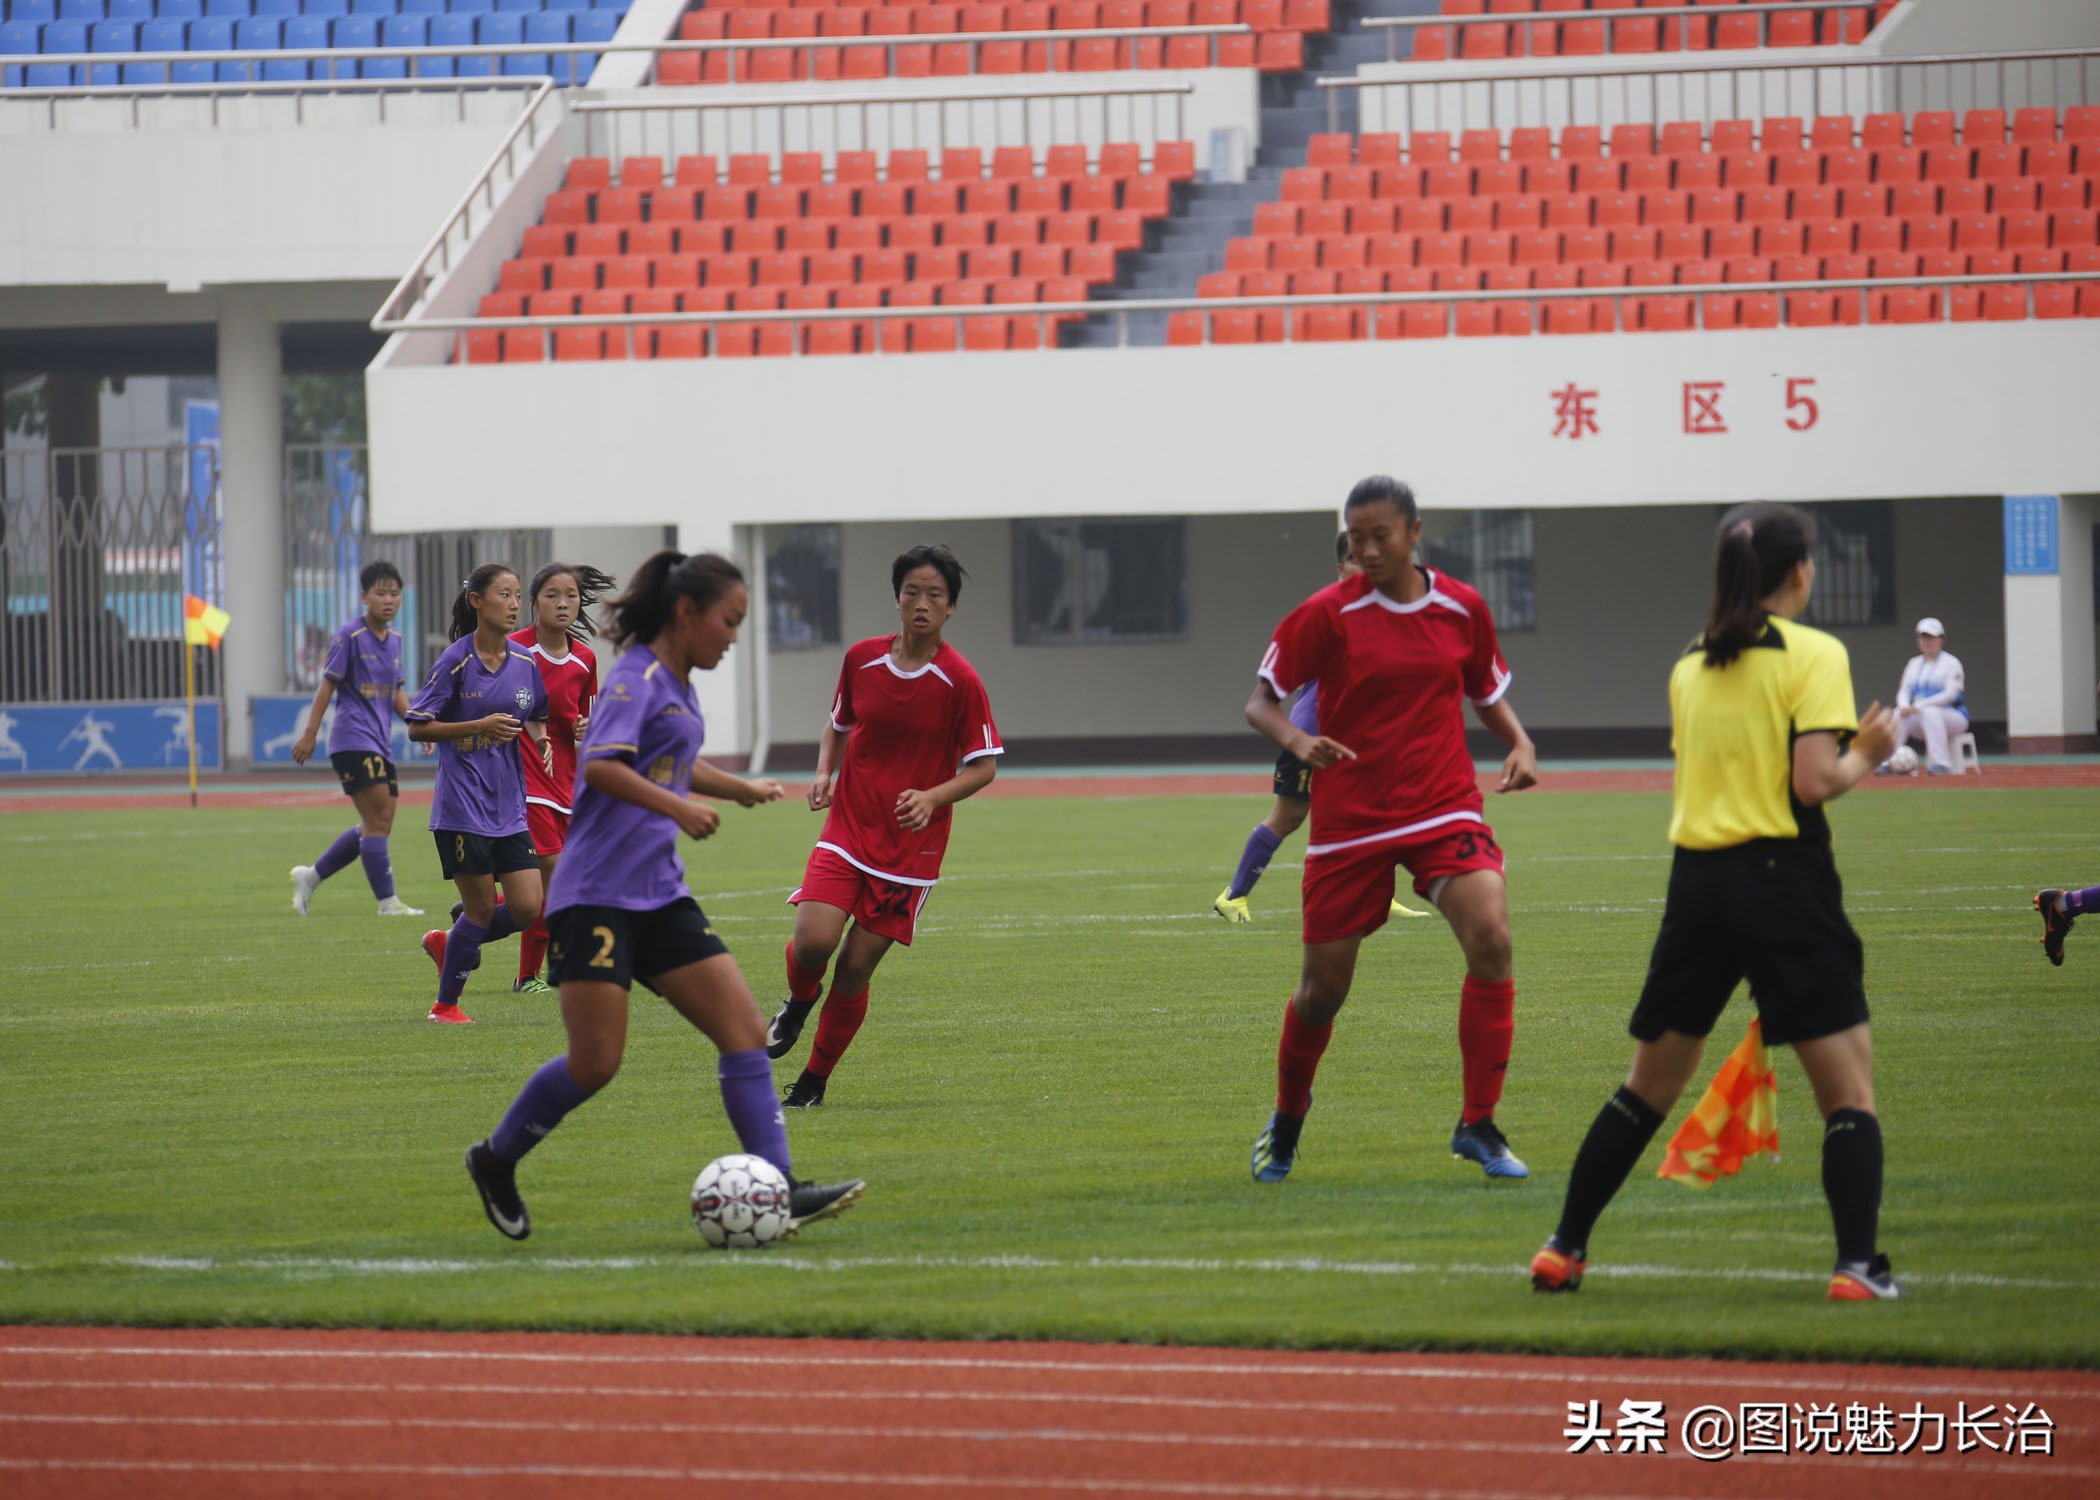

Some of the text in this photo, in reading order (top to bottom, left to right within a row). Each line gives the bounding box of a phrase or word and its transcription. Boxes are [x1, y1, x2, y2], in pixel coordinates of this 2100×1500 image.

[1550, 377, 1820, 439] 东 区 5
[363, 755, 386, 779] 12
[455, 834, 465, 862] 8
[589, 926, 615, 968] 2
